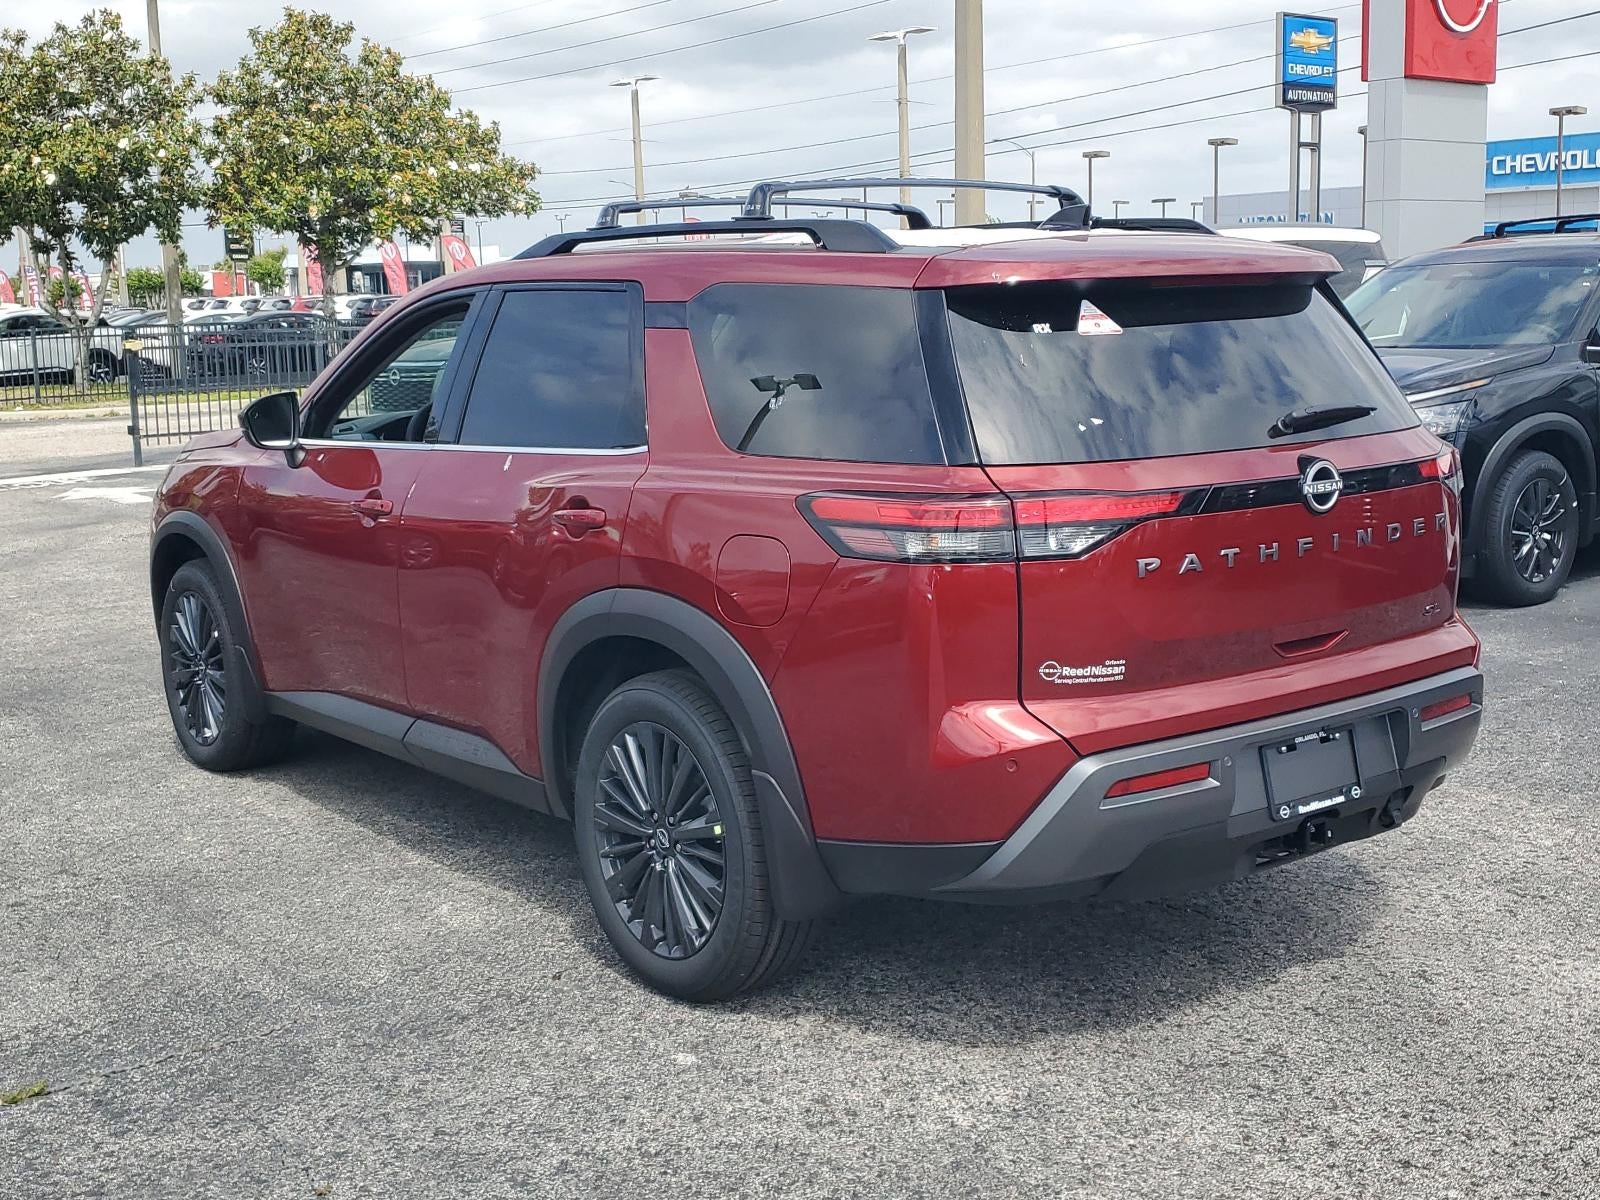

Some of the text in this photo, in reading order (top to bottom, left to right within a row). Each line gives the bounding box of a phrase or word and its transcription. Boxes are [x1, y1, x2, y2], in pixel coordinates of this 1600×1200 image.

[1288, 63, 1334, 77] CHEVROLET
[1287, 89, 1334, 102] AUTONATION
[1303, 480, 1343, 494] NISSAN
[1135, 511, 1447, 579] PATHFINDER
